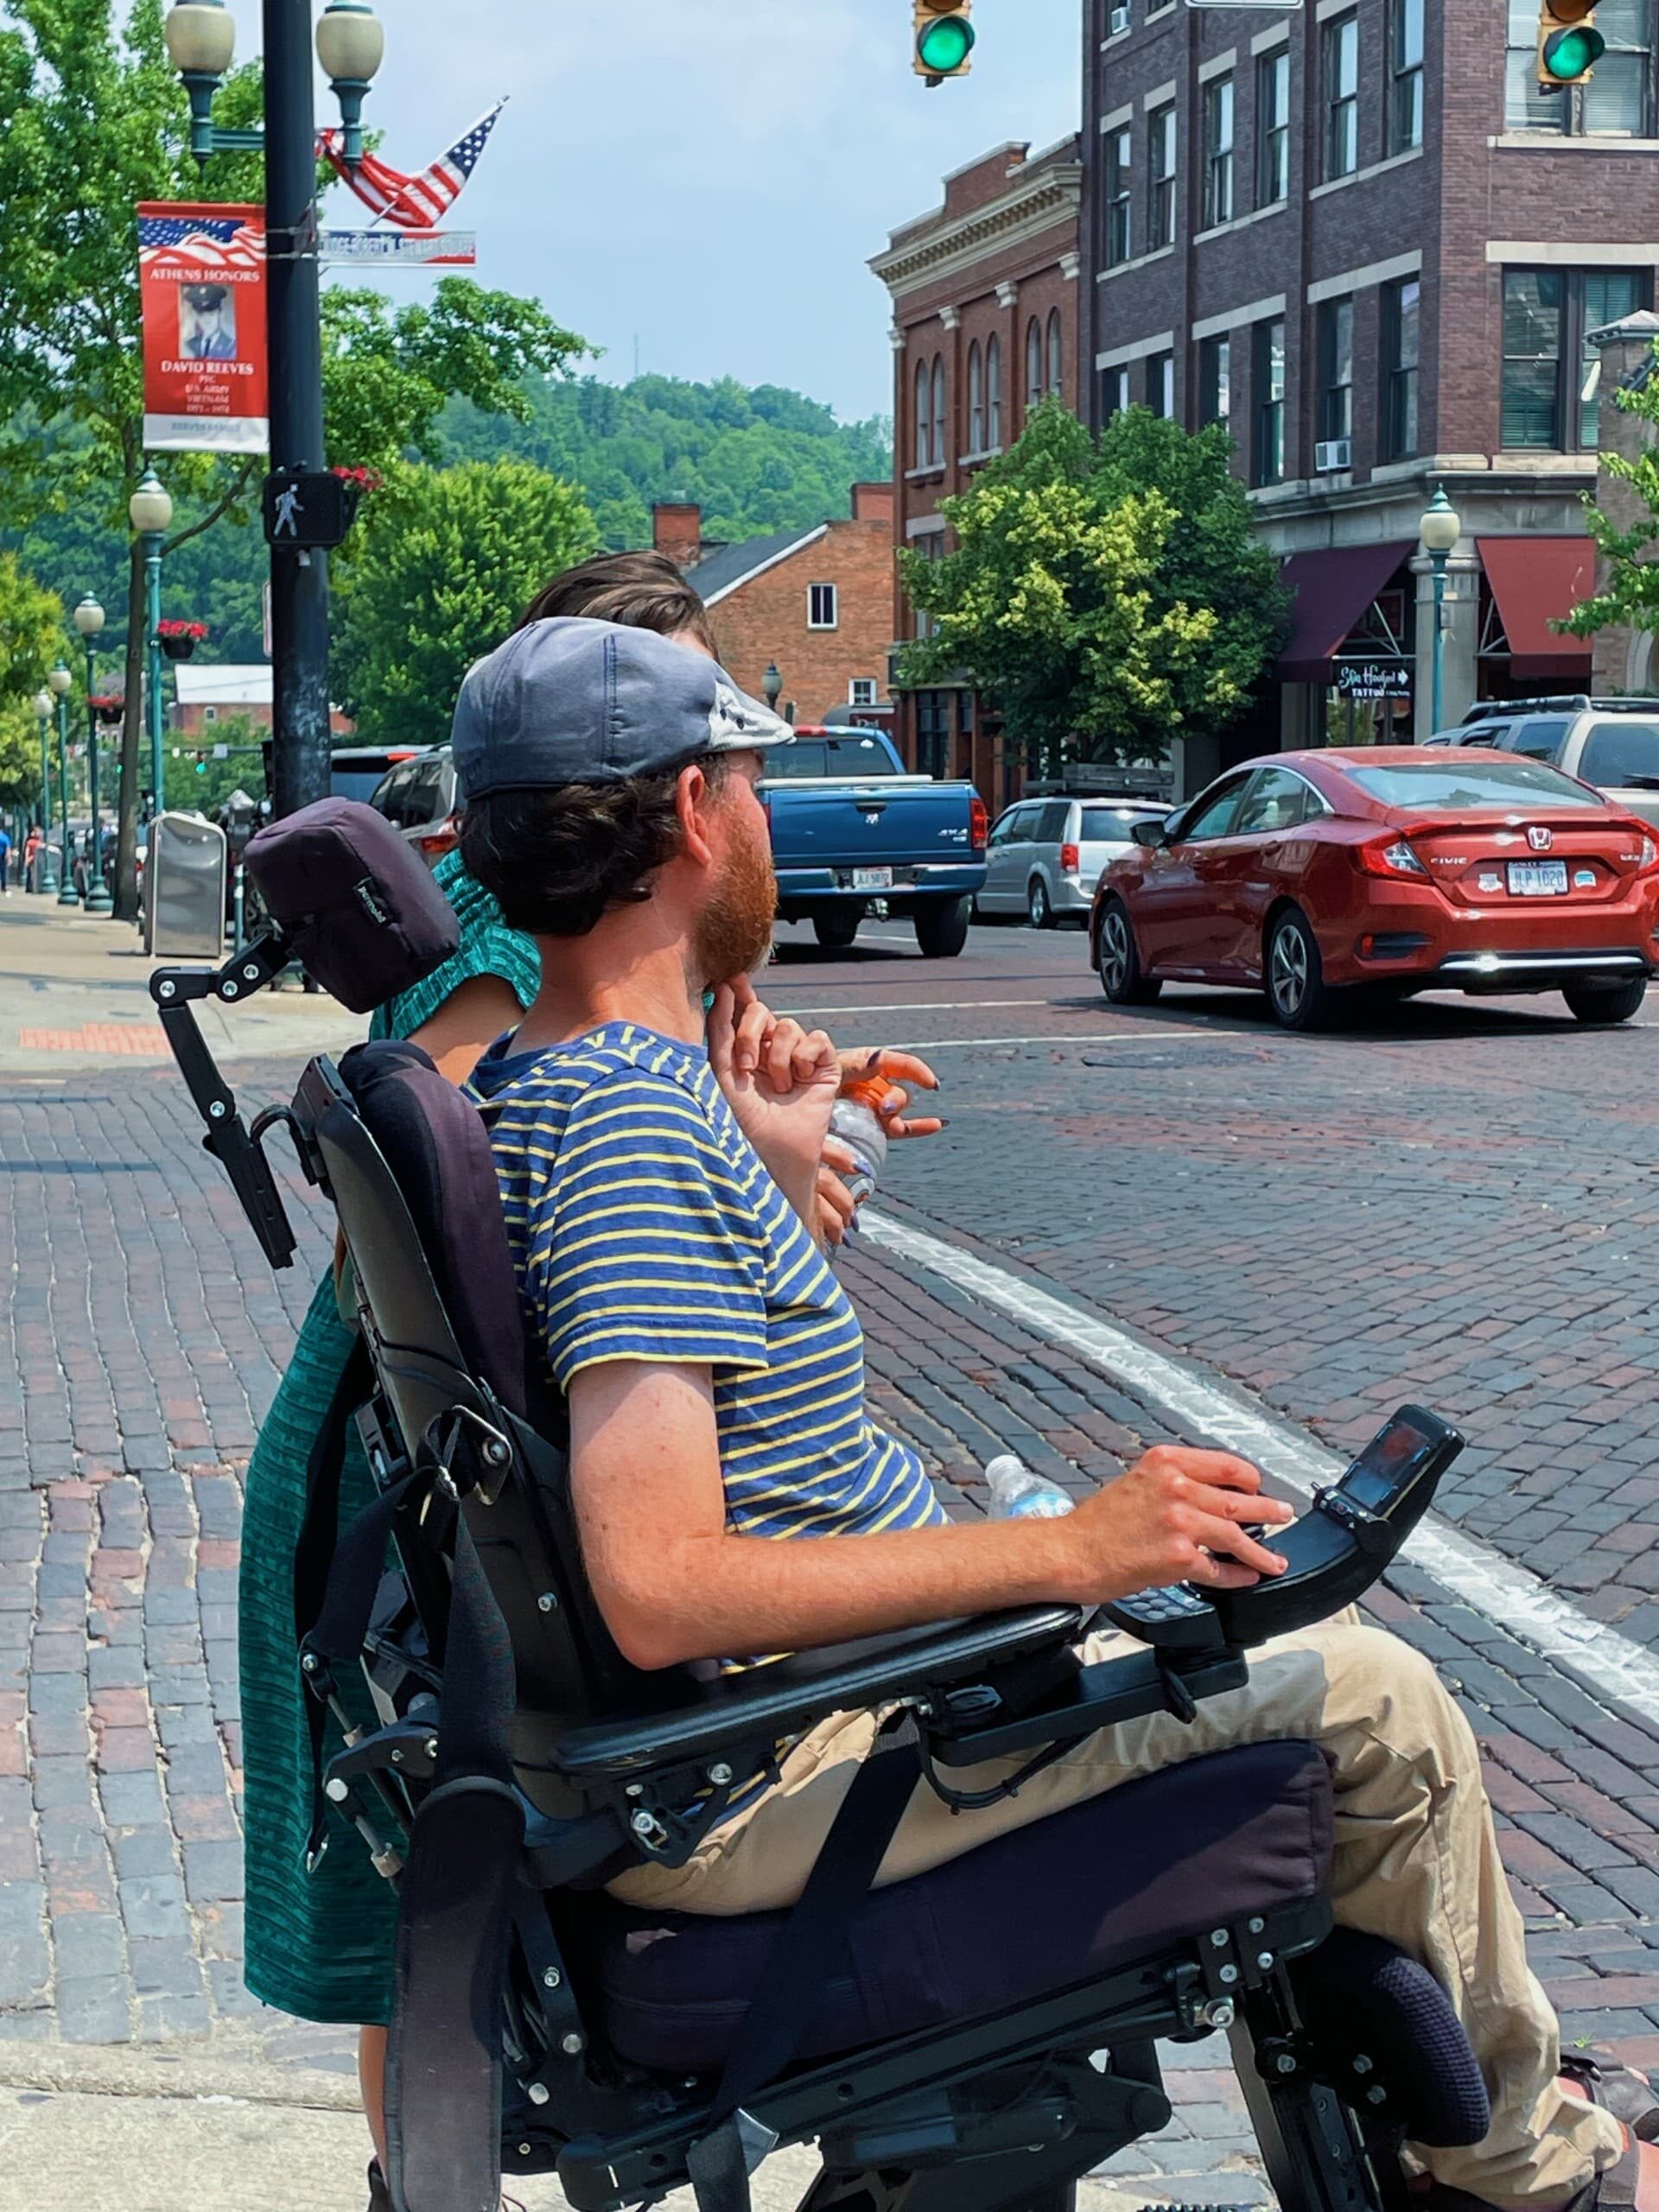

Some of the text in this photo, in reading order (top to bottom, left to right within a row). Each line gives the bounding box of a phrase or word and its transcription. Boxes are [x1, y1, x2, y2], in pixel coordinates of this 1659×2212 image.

[150, 268, 260, 283] ATHENS HONORS
[161, 359, 254, 375] DAVID REEVES
[202, 385, 230, 394] ARMY
[186, 394, 230, 404] VIETNAM
[1351, 688, 1384, 697] TATTOO
[1430, 856, 1468, 865] CIVIC
[1537, 870, 1564, 887] 1020
